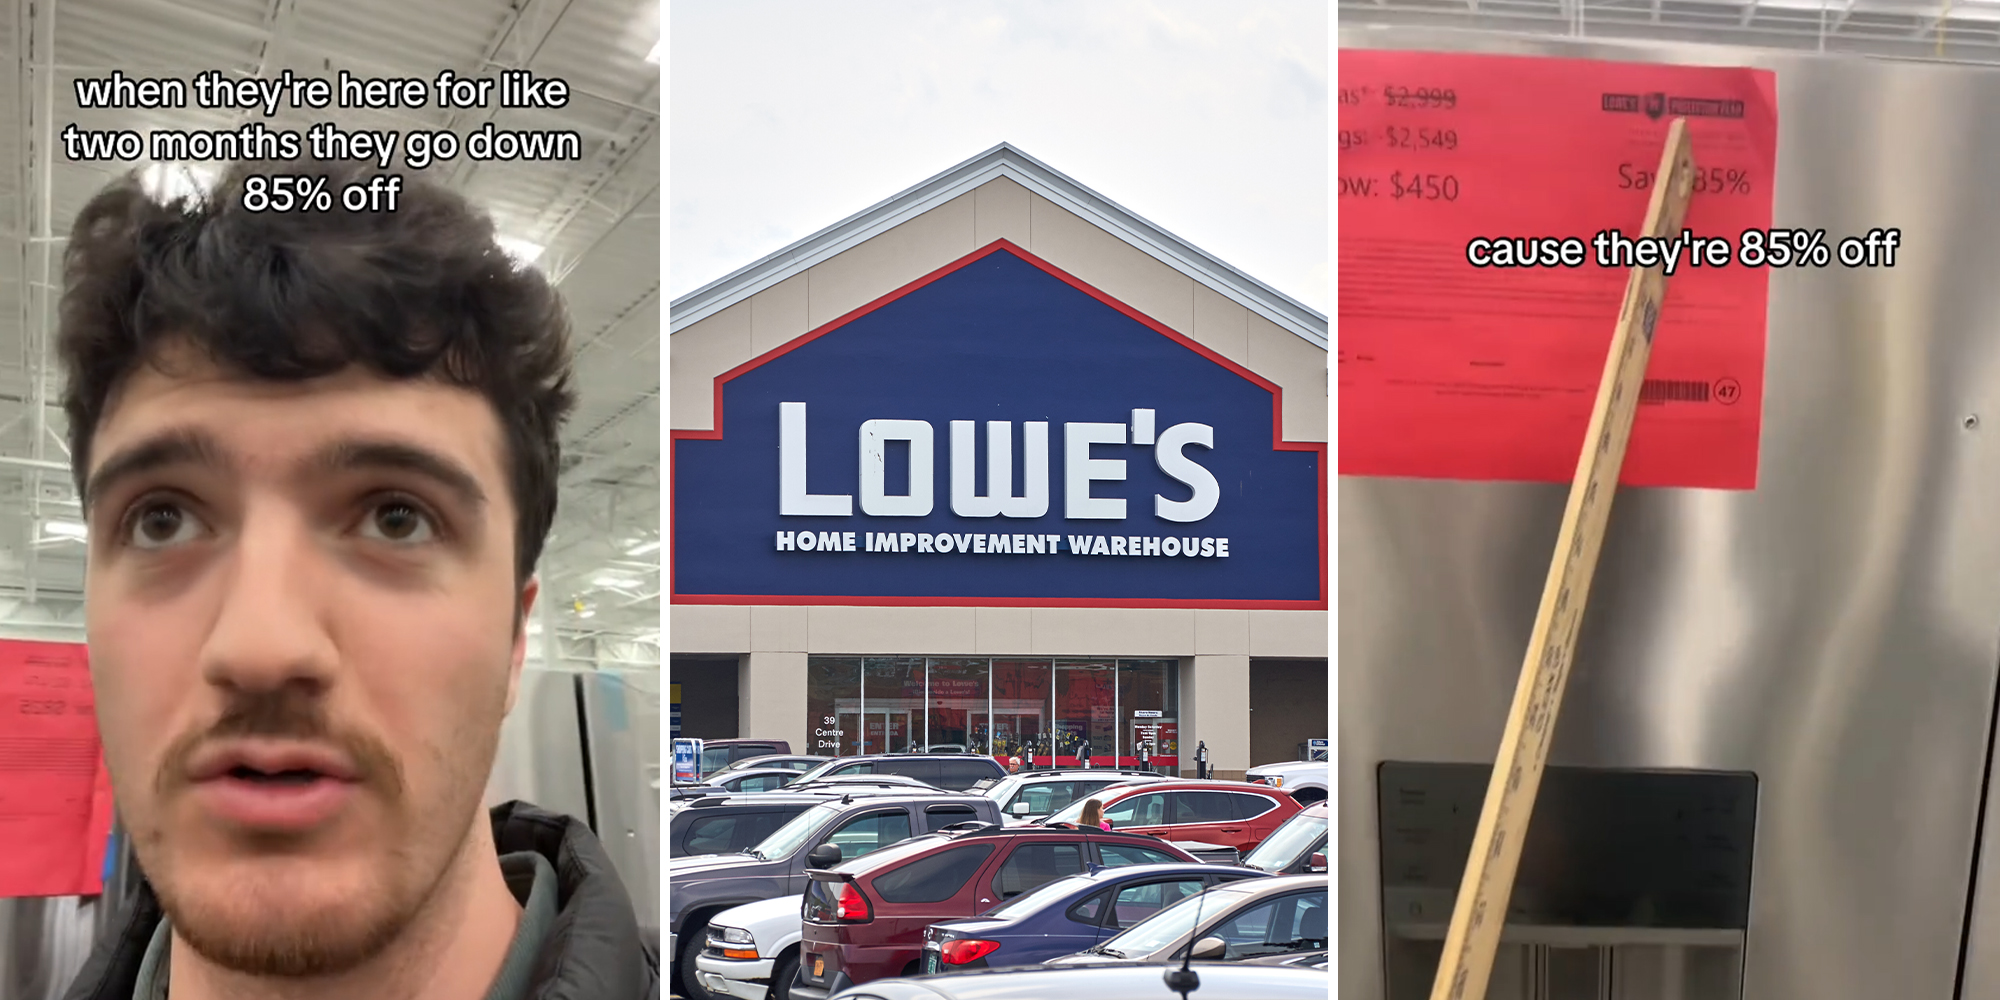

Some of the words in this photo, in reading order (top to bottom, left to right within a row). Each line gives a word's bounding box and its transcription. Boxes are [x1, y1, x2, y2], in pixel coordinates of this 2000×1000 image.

[1386, 126, 1457, 151] $2,549
[1390, 170, 1459, 202] $450
[1718, 386, 1736, 398] 47
[778, 401, 1221, 523] LOWE'S
[776, 530, 856, 552] HOME
[864, 531, 1061, 555] IMPROVEMENT
[1067, 534, 1230, 558] WAREHOUSE
[823, 716, 836, 725] 39
[815, 728, 844, 737] Centre
[818, 740, 841, 748] Drive
